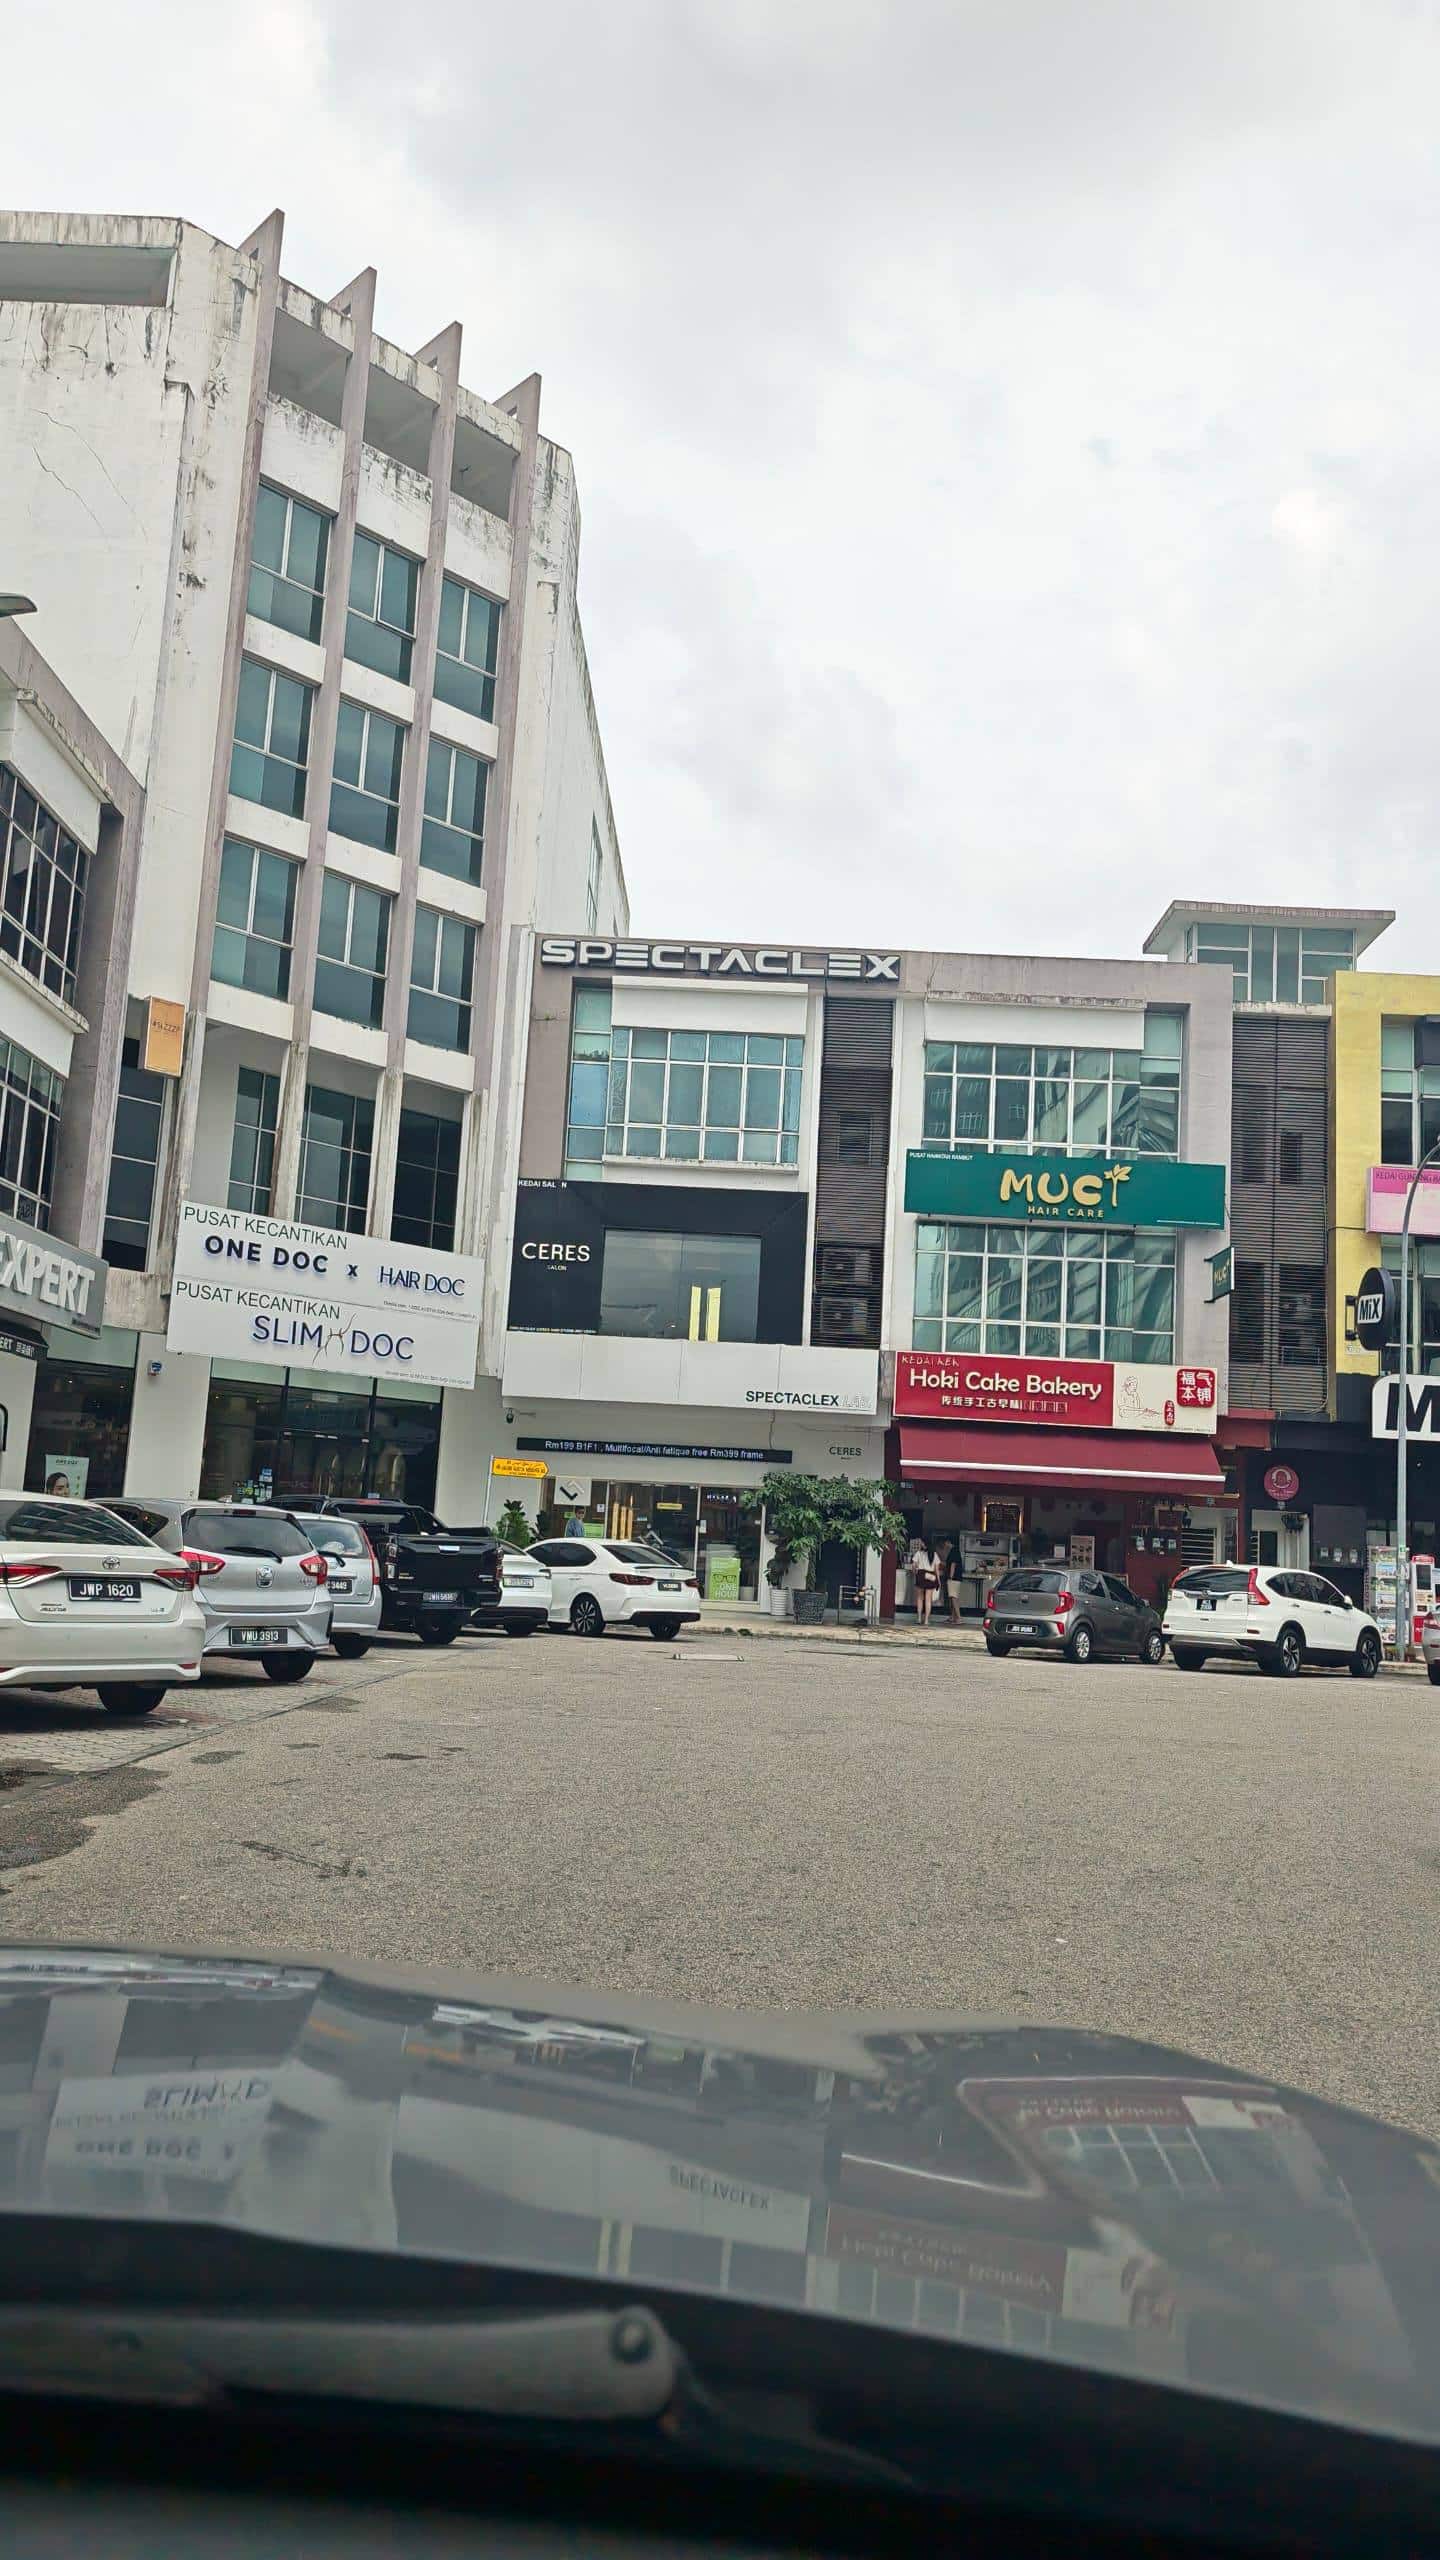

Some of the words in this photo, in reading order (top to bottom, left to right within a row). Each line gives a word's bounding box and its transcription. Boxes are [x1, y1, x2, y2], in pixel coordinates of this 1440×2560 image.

[541, 939, 901, 980] SPECTACLEX
[1027, 1205, 1060, 1216] HAIR
[1067, 1207, 1105, 1218] CARE
[184, 1207, 240, 1230] PUSAT
[245, 1218, 348, 1250] KECANTIKAN
[204, 1235, 262, 1263] ONE
[273, 1247, 329, 1273] DOC
[379, 1266, 420, 1290] HAIR
[425, 1277, 465, 1297] DOC
[521, 1242, 591, 1262] CERES
[176, 1281, 233, 1304] PUSAT
[237, 1290, 341, 1320] KECANTIKAN
[252, 1316, 324, 1349] SLIM
[351, 1330, 415, 1360] DOC
[746, 1391, 839, 1406] SPECTACLEX
[910, 1368, 959, 1389] Hoki
[965, 1371, 1020, 1392] Cake
[1027, 1374, 1102, 1399] Bakery
[829, 1446, 862, 1456] CERES
[80, 1582, 103, 1597] JWP
[107, 1582, 134, 1597] 1620
